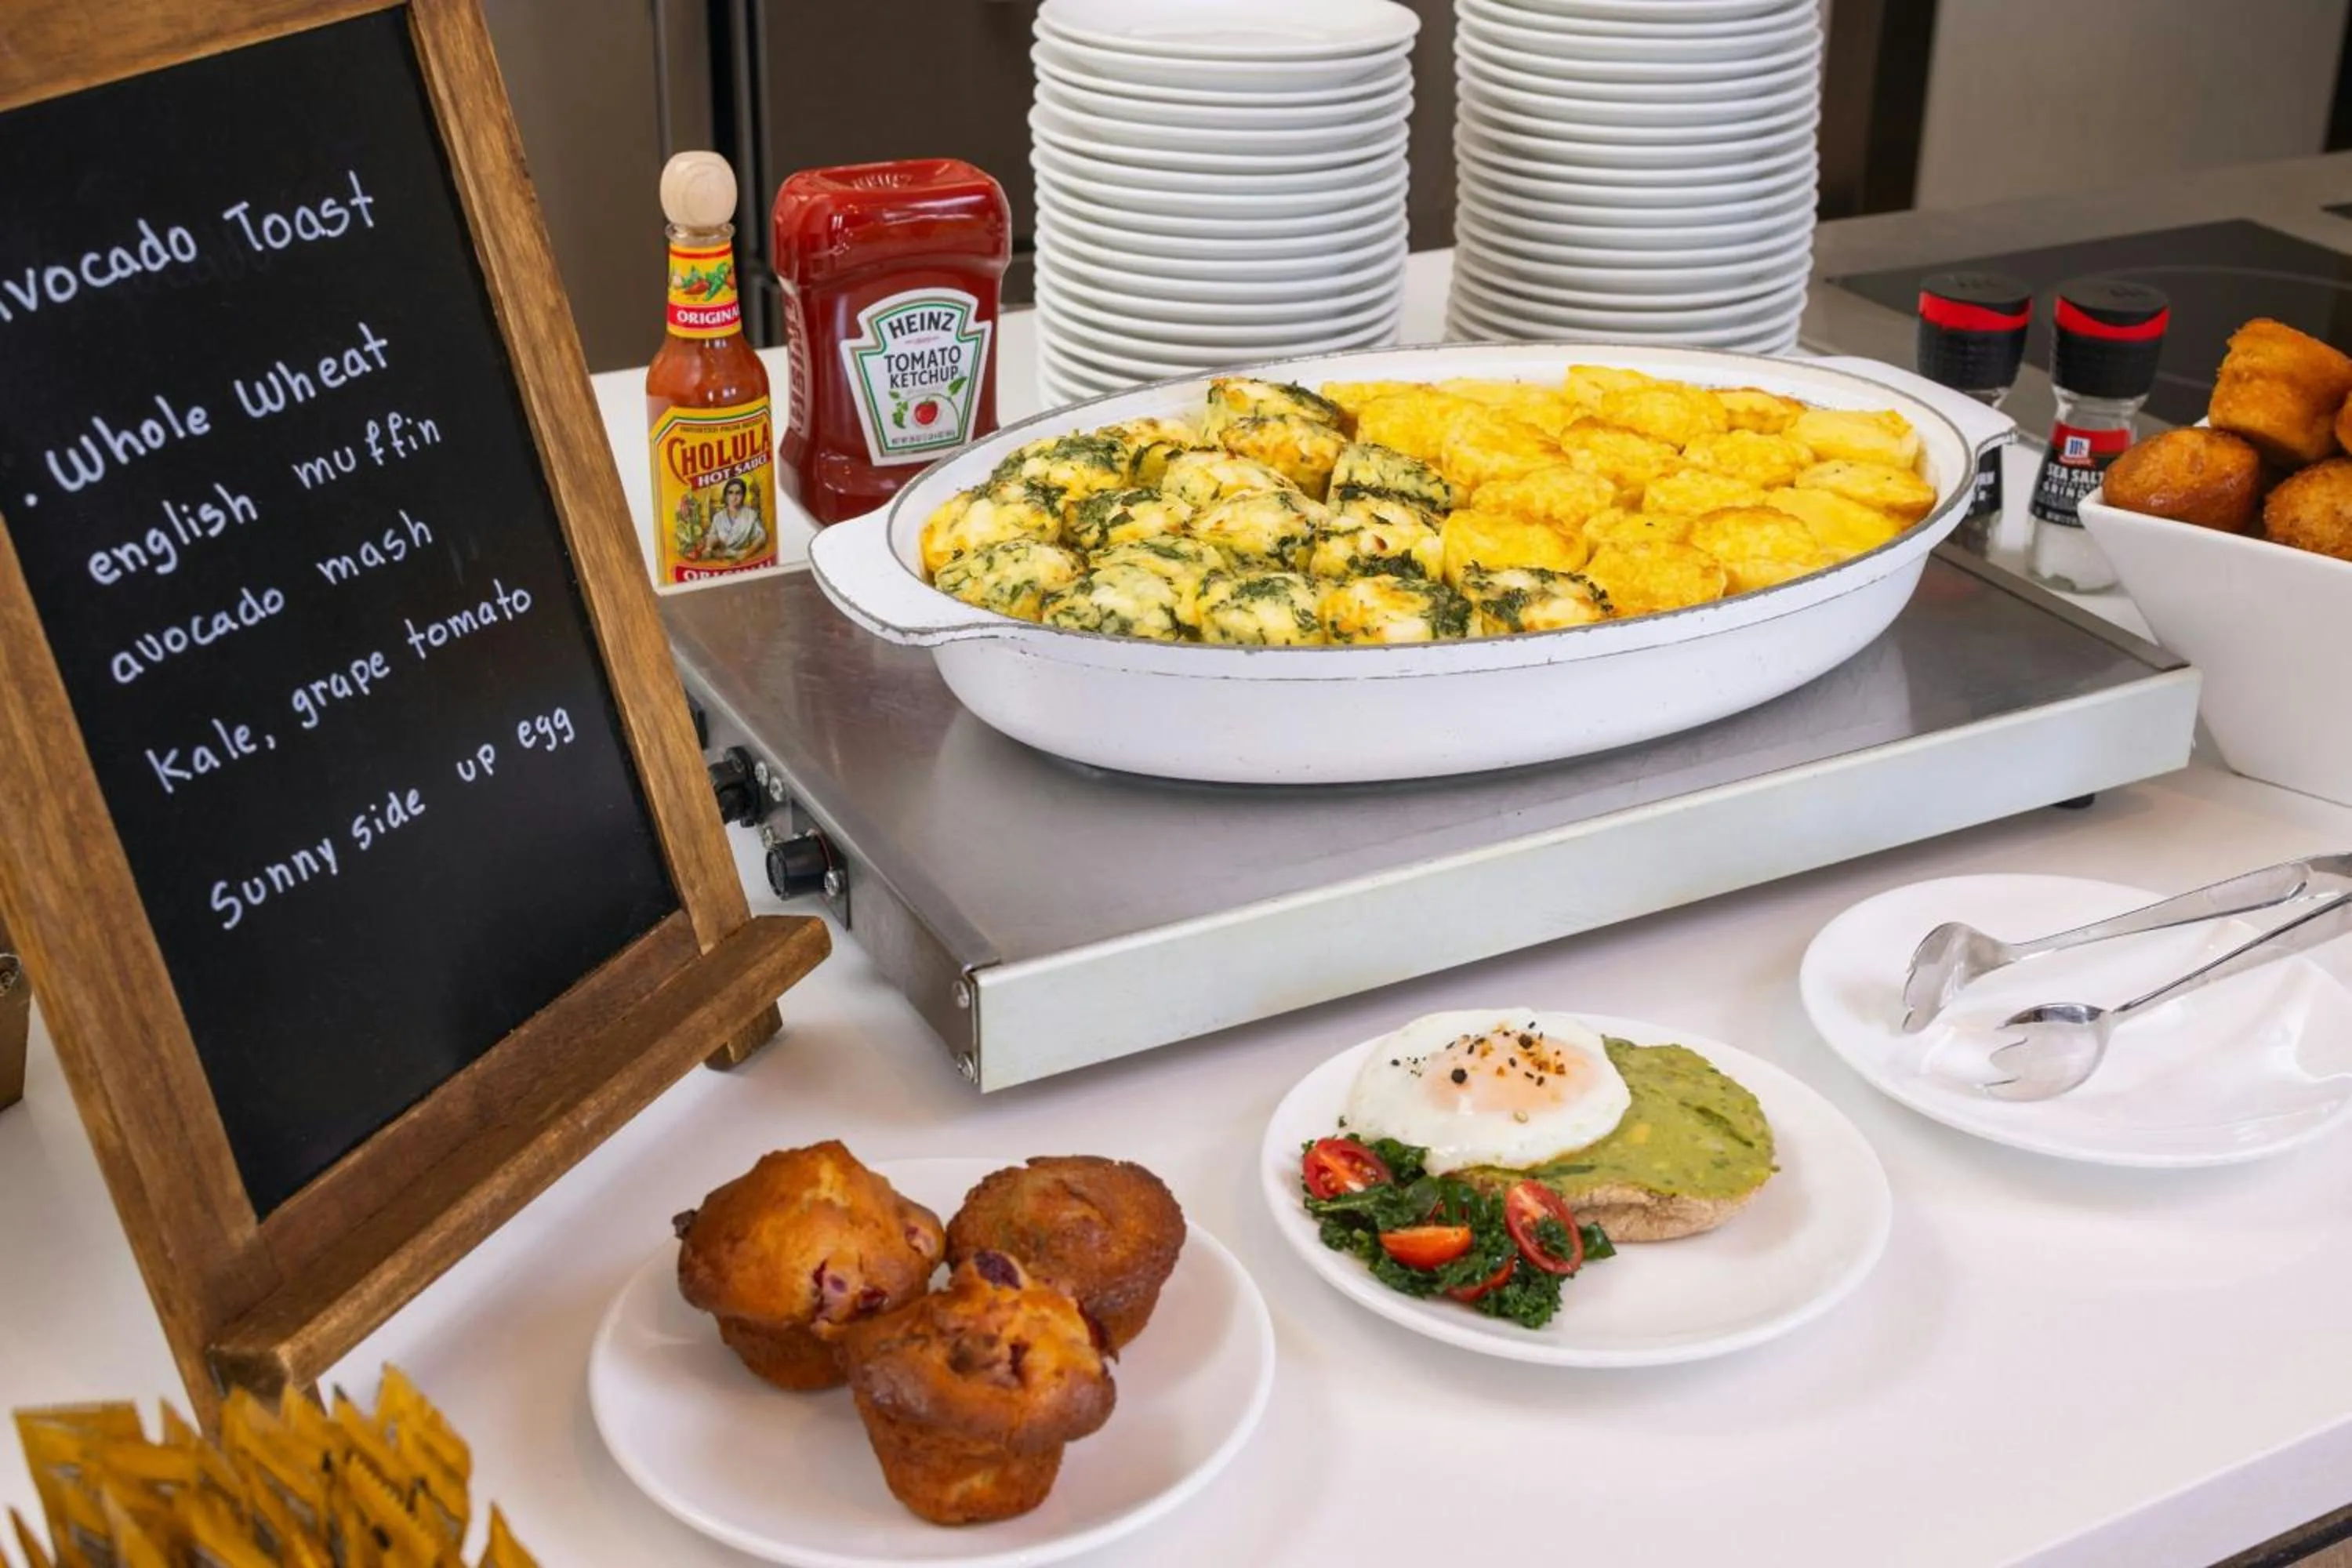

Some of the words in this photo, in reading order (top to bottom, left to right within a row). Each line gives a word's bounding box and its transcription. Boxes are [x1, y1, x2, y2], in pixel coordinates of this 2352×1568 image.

[223, 170, 375, 252] Toast
[676, 304, 741, 325] ORIGINA
[887, 311, 955, 339] HEINZ
[884, 345, 962, 373] TOMATO
[889, 366, 960, 389] KETCHUP
[45, 395, 212, 492] Whole
[234, 322, 389, 419] Wheat
[667, 423, 771, 486] CHOLULA
[698, 468, 731, 487] HOT
[734, 453, 768, 477] SAUC
[89, 483, 259, 585] english
[292, 412, 441, 490] muffin
[2042, 480, 2088, 499] GRIND
[111, 586, 285, 684] avocado
[316, 510, 434, 585] mash
[292, 651, 391, 730] grape
[405, 579, 532, 660] tomato
[210, 837, 339, 930] Sunny
[351, 788, 426, 851] side
[456, 742, 496, 782] up
[517, 706, 575, 753] egg
